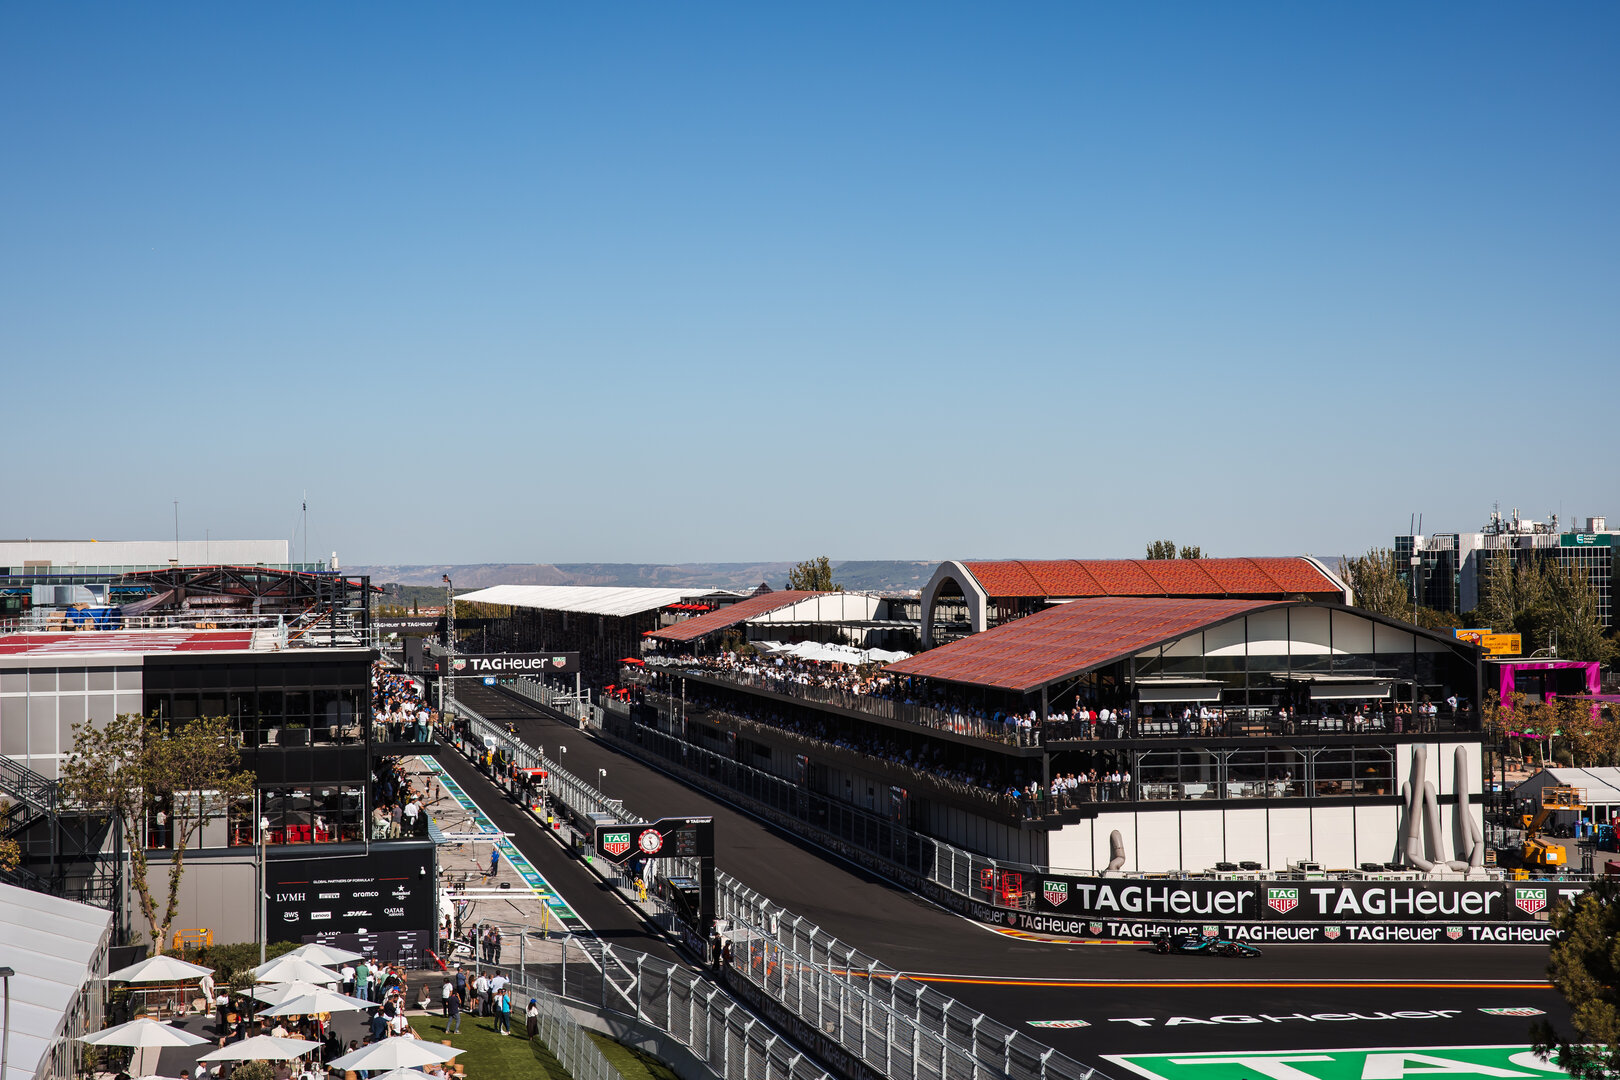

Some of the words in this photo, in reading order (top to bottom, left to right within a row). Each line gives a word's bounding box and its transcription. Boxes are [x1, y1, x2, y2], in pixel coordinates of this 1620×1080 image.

[606, 834, 628, 842] TAG
[605, 843, 629, 854] HEUER
[1045, 882, 1066, 892] TAG
[1270, 889, 1296, 898] TAG
[276, 893, 306, 902] LVMH
[1045, 892, 1067, 906] HEUER
[1076, 883, 1254, 915] TAGHeuer
[1518, 890, 1544, 898] TAG
[1269, 899, 1298, 912] HEUER
[1310, 888, 1501, 915] TAGHeuer
[1516, 900, 1546, 913] HEUER
[283, 911, 299, 919] aws
[1224, 926, 1319, 940] TAGHeuer
[1346, 926, 1441, 940] TAGHeuer
[1107, 1010, 1462, 1027] TAGHeuer
